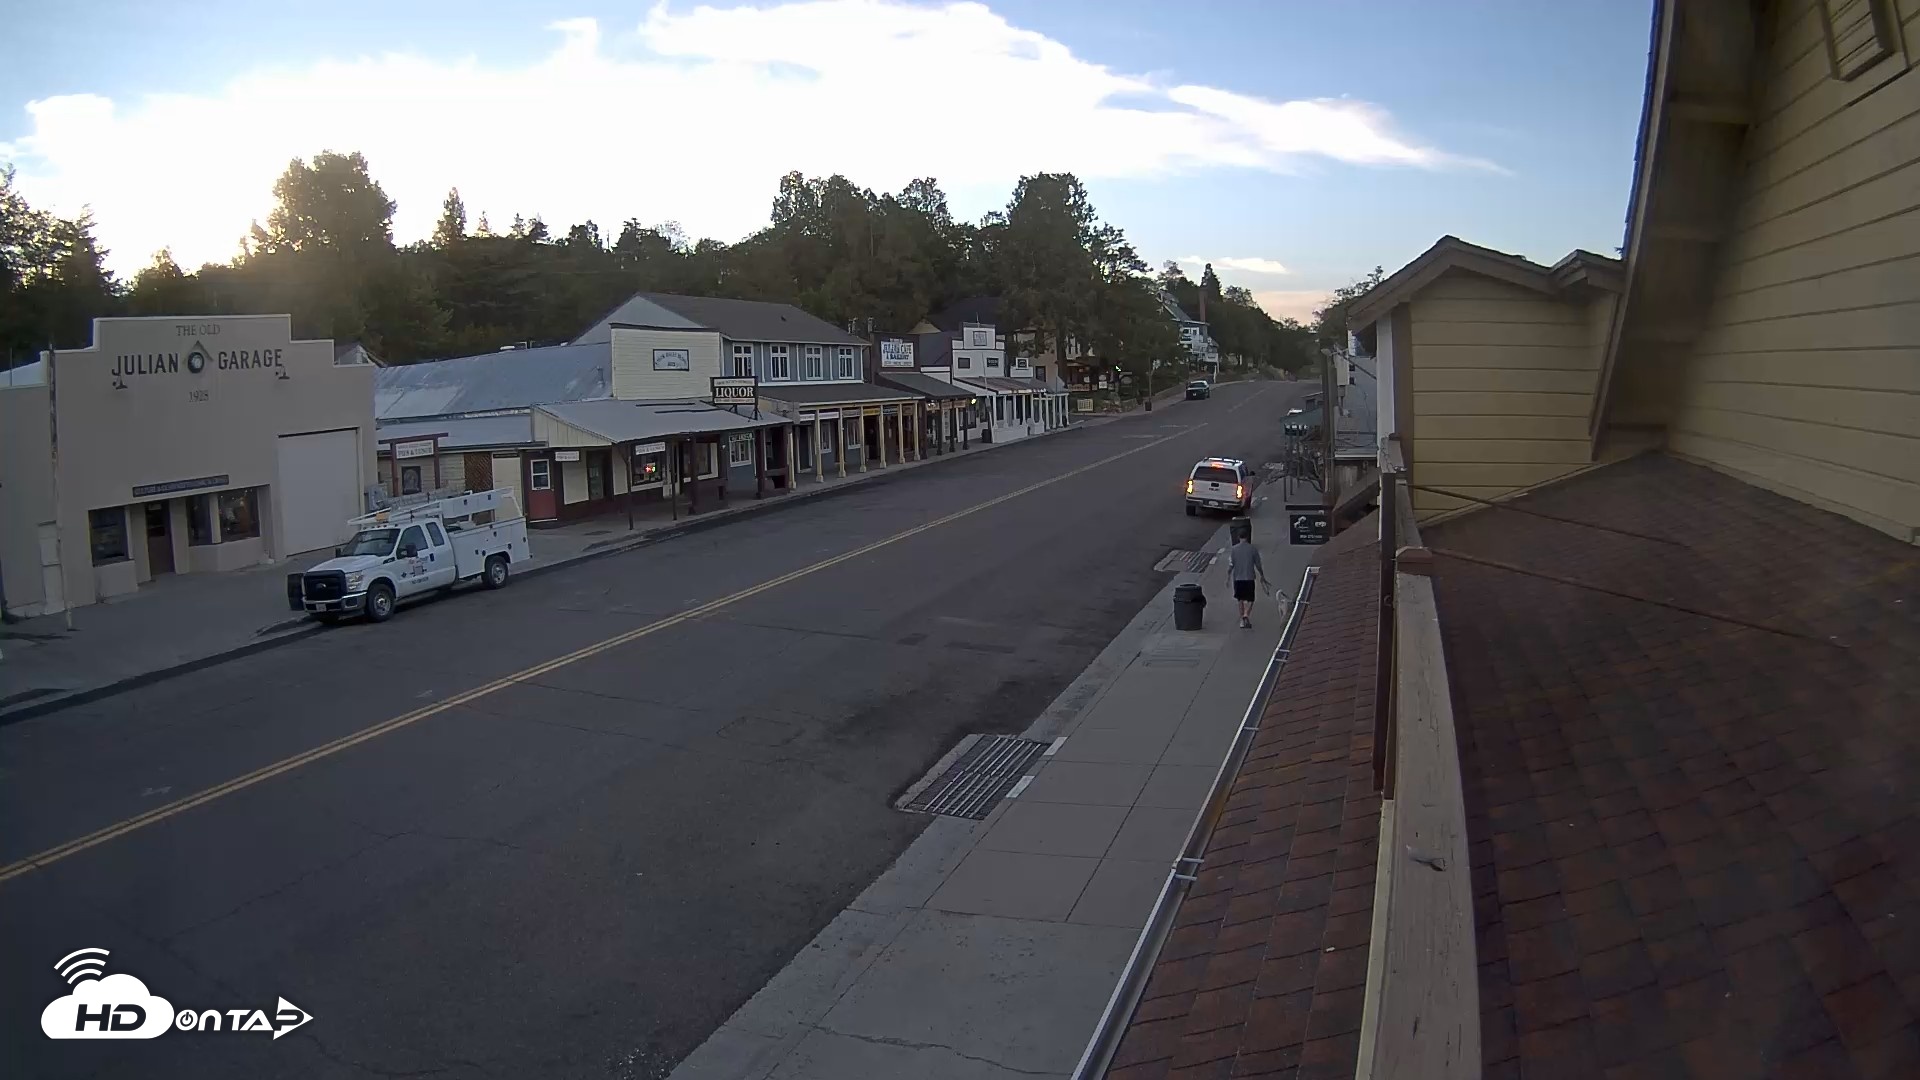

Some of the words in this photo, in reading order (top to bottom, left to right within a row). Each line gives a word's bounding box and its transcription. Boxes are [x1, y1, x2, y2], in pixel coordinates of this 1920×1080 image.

[176, 325, 196, 336] THE
[200, 324, 221, 336] OLD
[112, 353, 178, 376] JULIAN
[218, 349, 283, 370] GARAGE
[715, 386, 754, 398] LIQUOR
